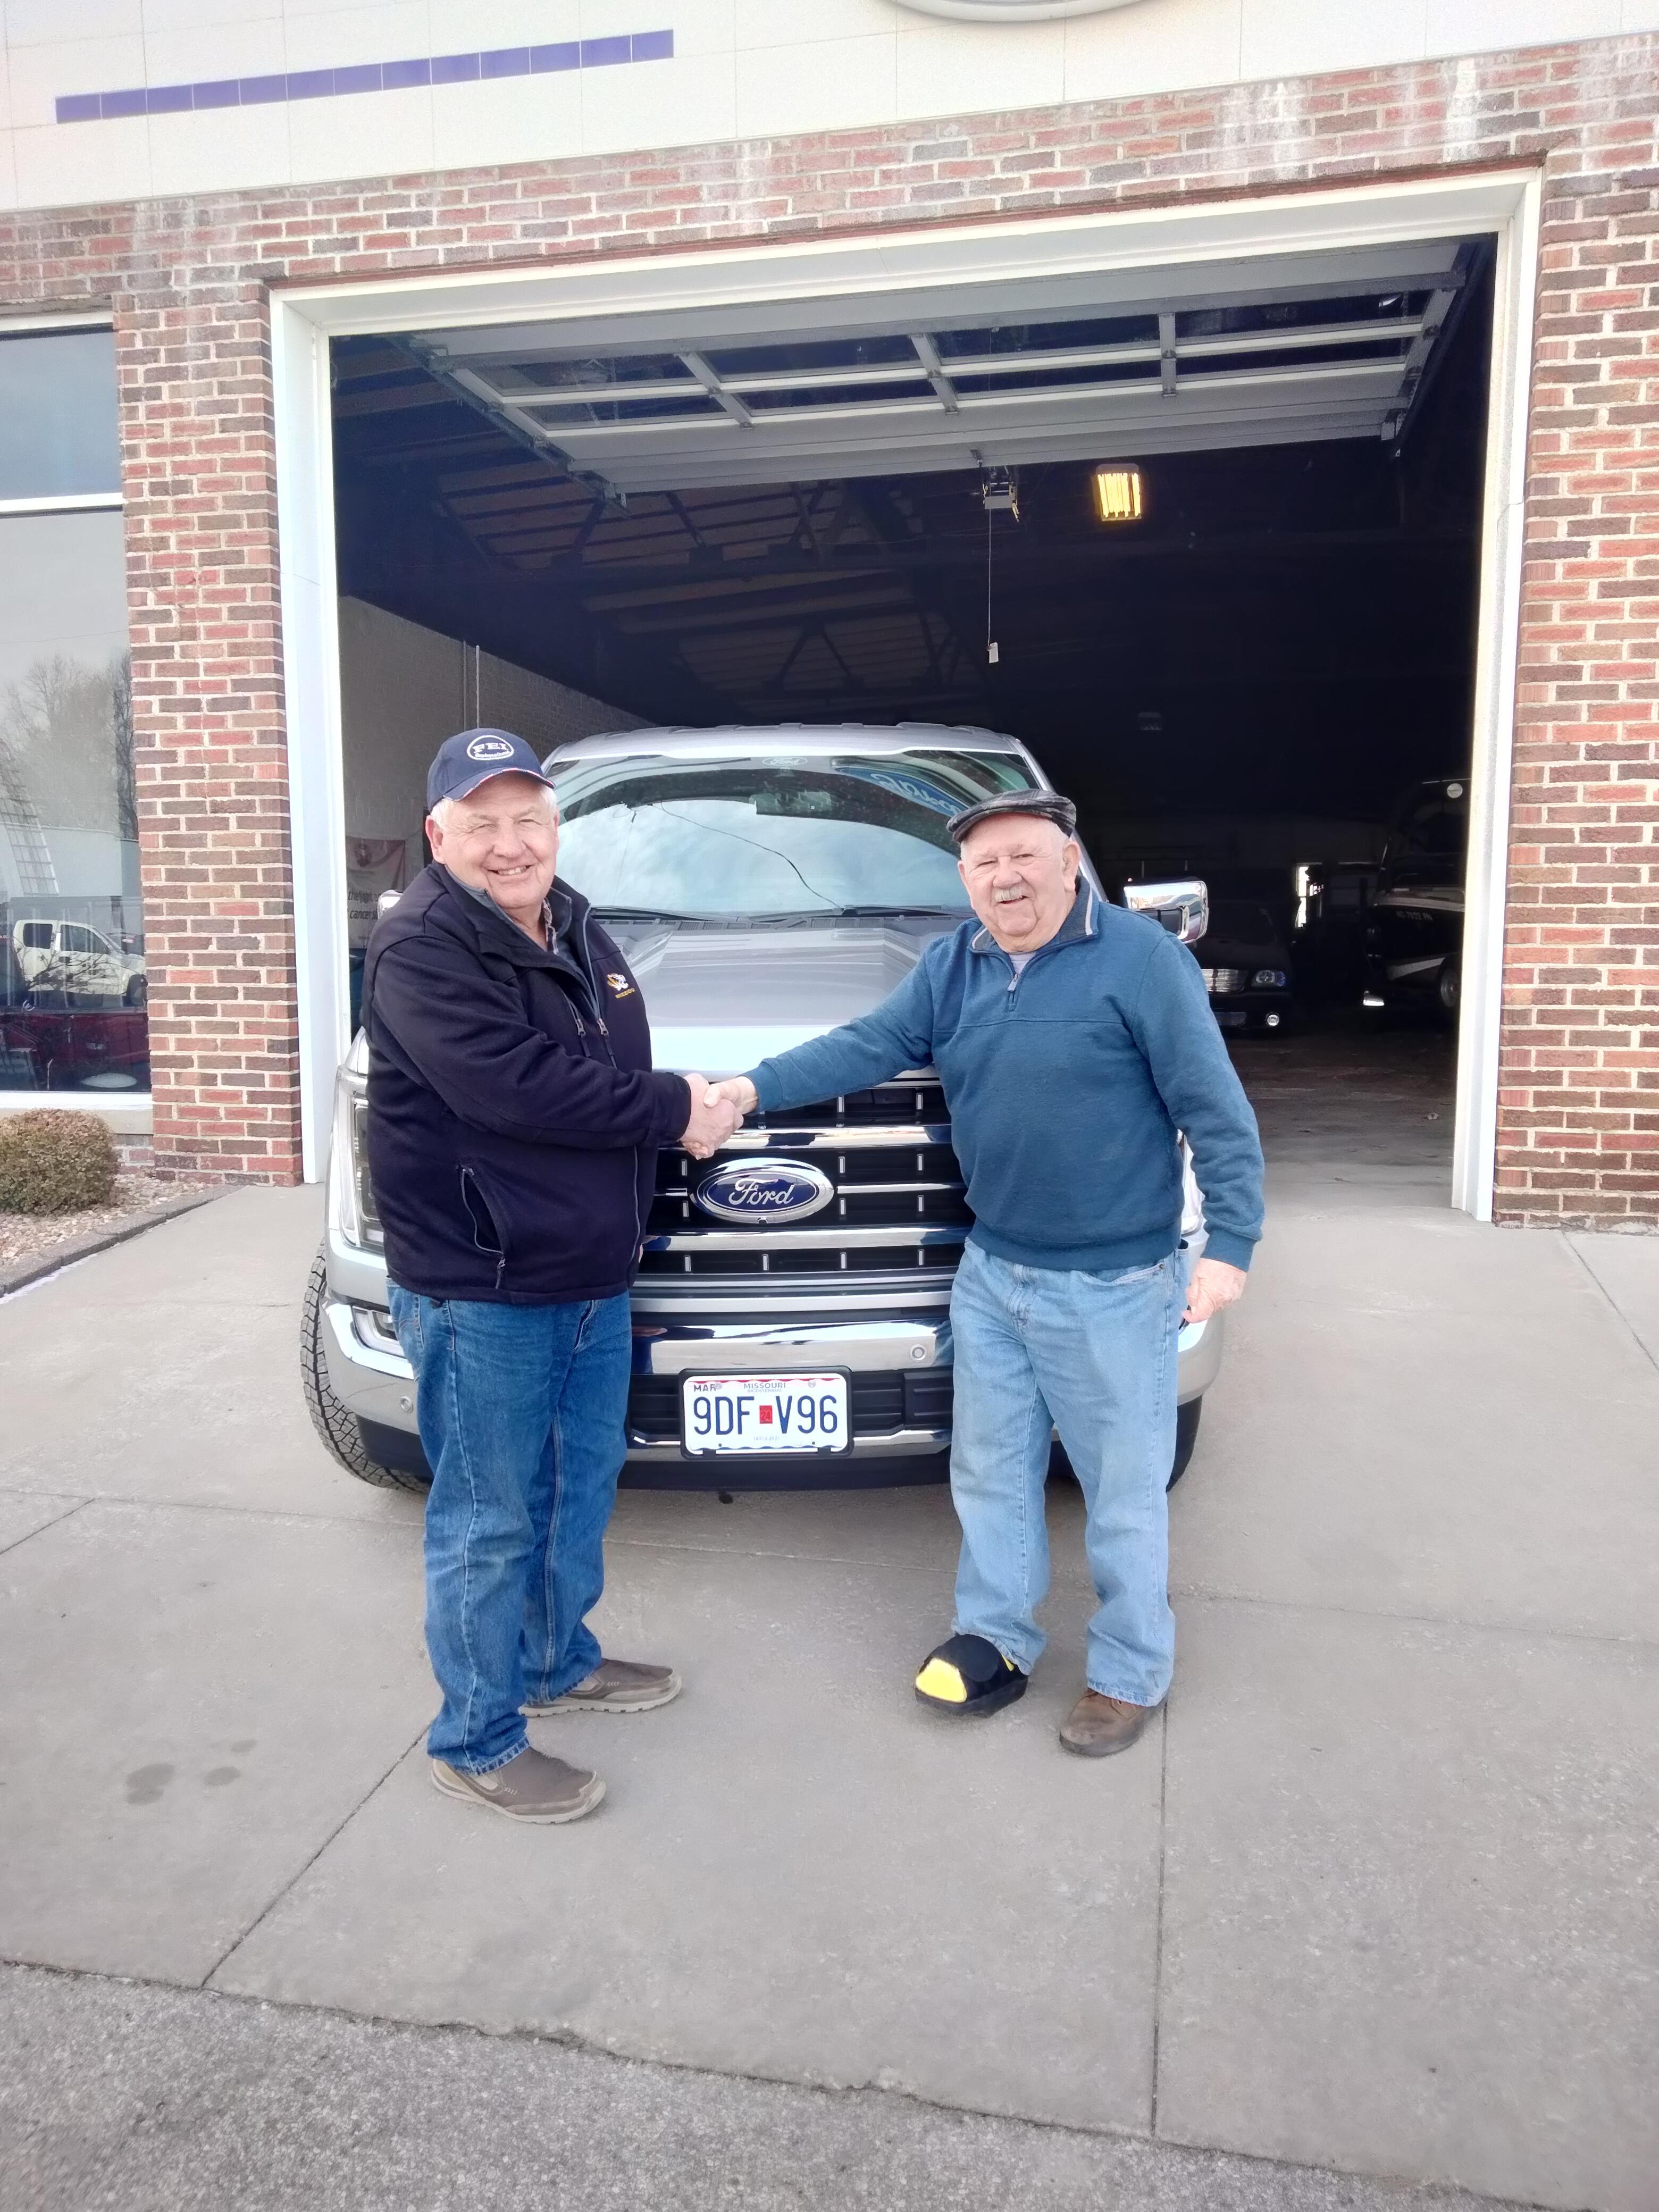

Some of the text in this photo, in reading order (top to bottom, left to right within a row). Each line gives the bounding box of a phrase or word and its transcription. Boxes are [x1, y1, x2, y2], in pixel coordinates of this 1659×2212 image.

[472, 742, 507, 753] FEI
[348, 890, 358, 900] the
[349, 910, 372, 919] cancer
[728, 1178, 795, 1205] Ford
[693, 1384, 716, 1392] MAR
[693, 1395, 837, 1435] 9DF V96
[761, 1411, 770, 1421] 24
